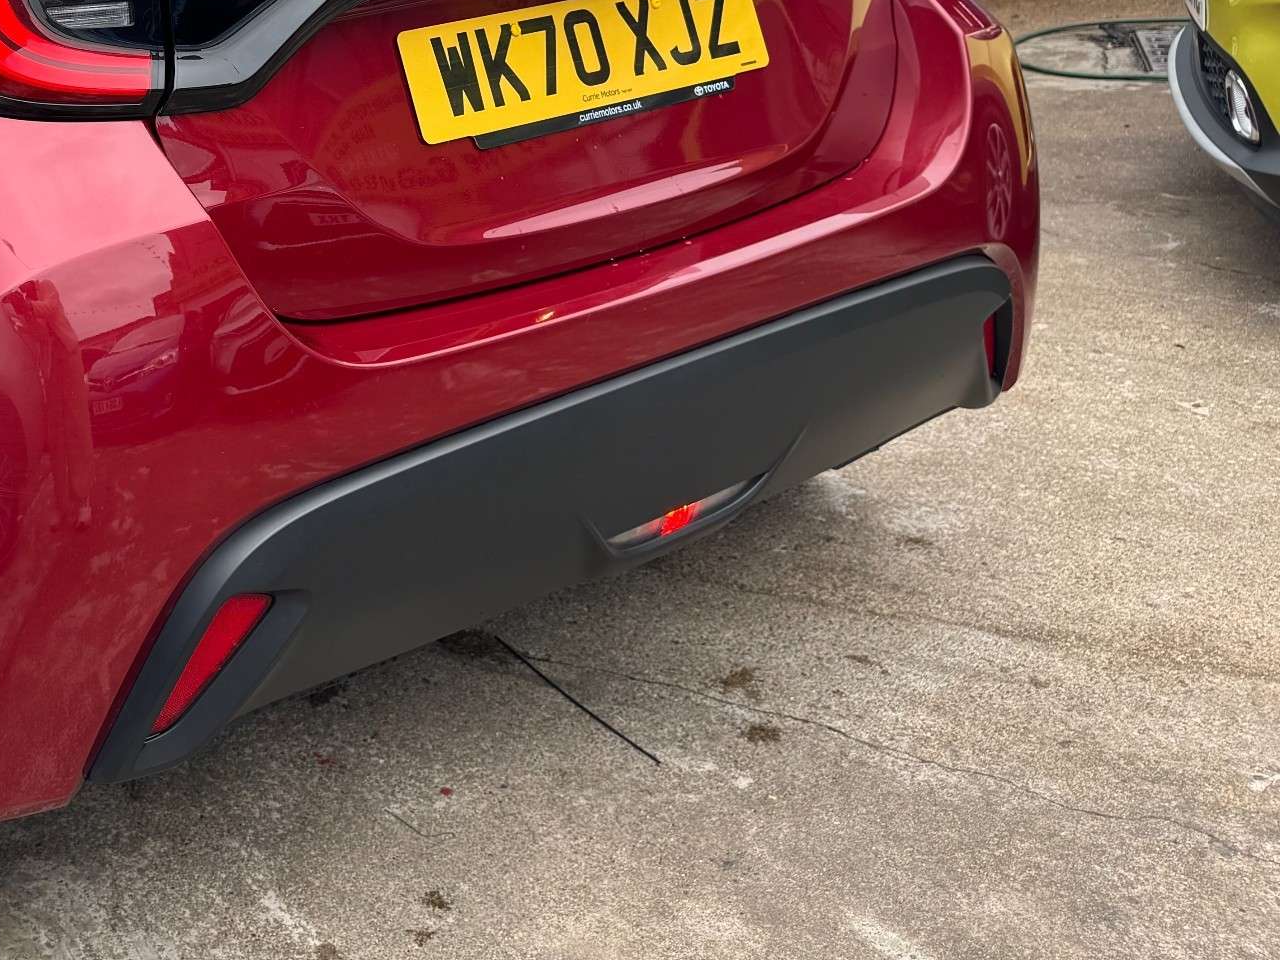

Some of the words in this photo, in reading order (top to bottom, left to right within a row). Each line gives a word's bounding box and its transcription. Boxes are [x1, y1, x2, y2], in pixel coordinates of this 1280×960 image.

[429, 8, 612, 117] WK70
[601, 88, 621, 99] Motors
[704, 81, 730, 94] TOYOTA
[579, 100, 643, 123] curriemotors.co.uk
